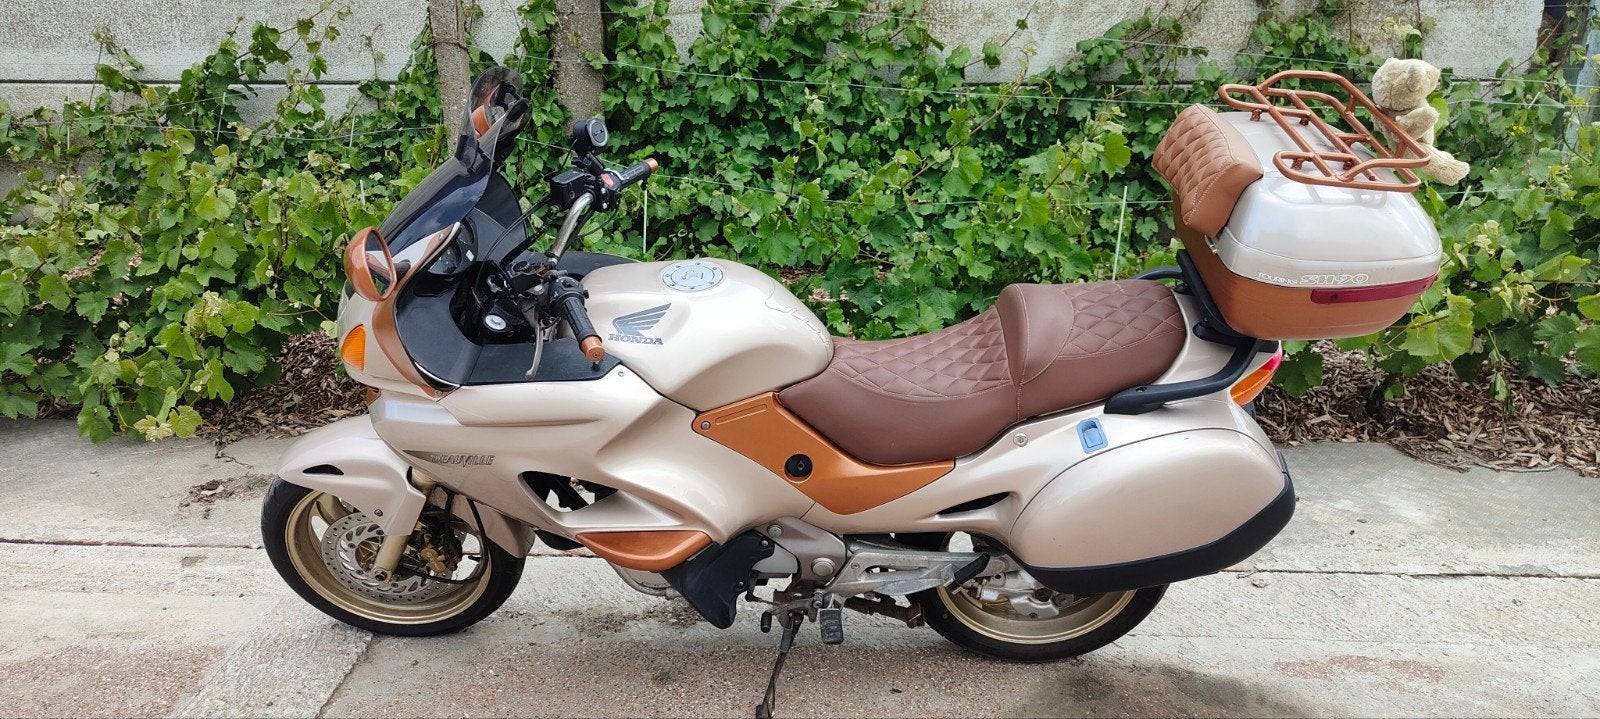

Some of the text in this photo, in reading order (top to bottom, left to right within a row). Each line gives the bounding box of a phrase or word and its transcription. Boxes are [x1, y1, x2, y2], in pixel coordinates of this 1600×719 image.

[1257, 272, 1369, 285] TOURING SH90
[608, 333, 664, 346] HONDA
[430, 453, 496, 468] DEAUVILLE
